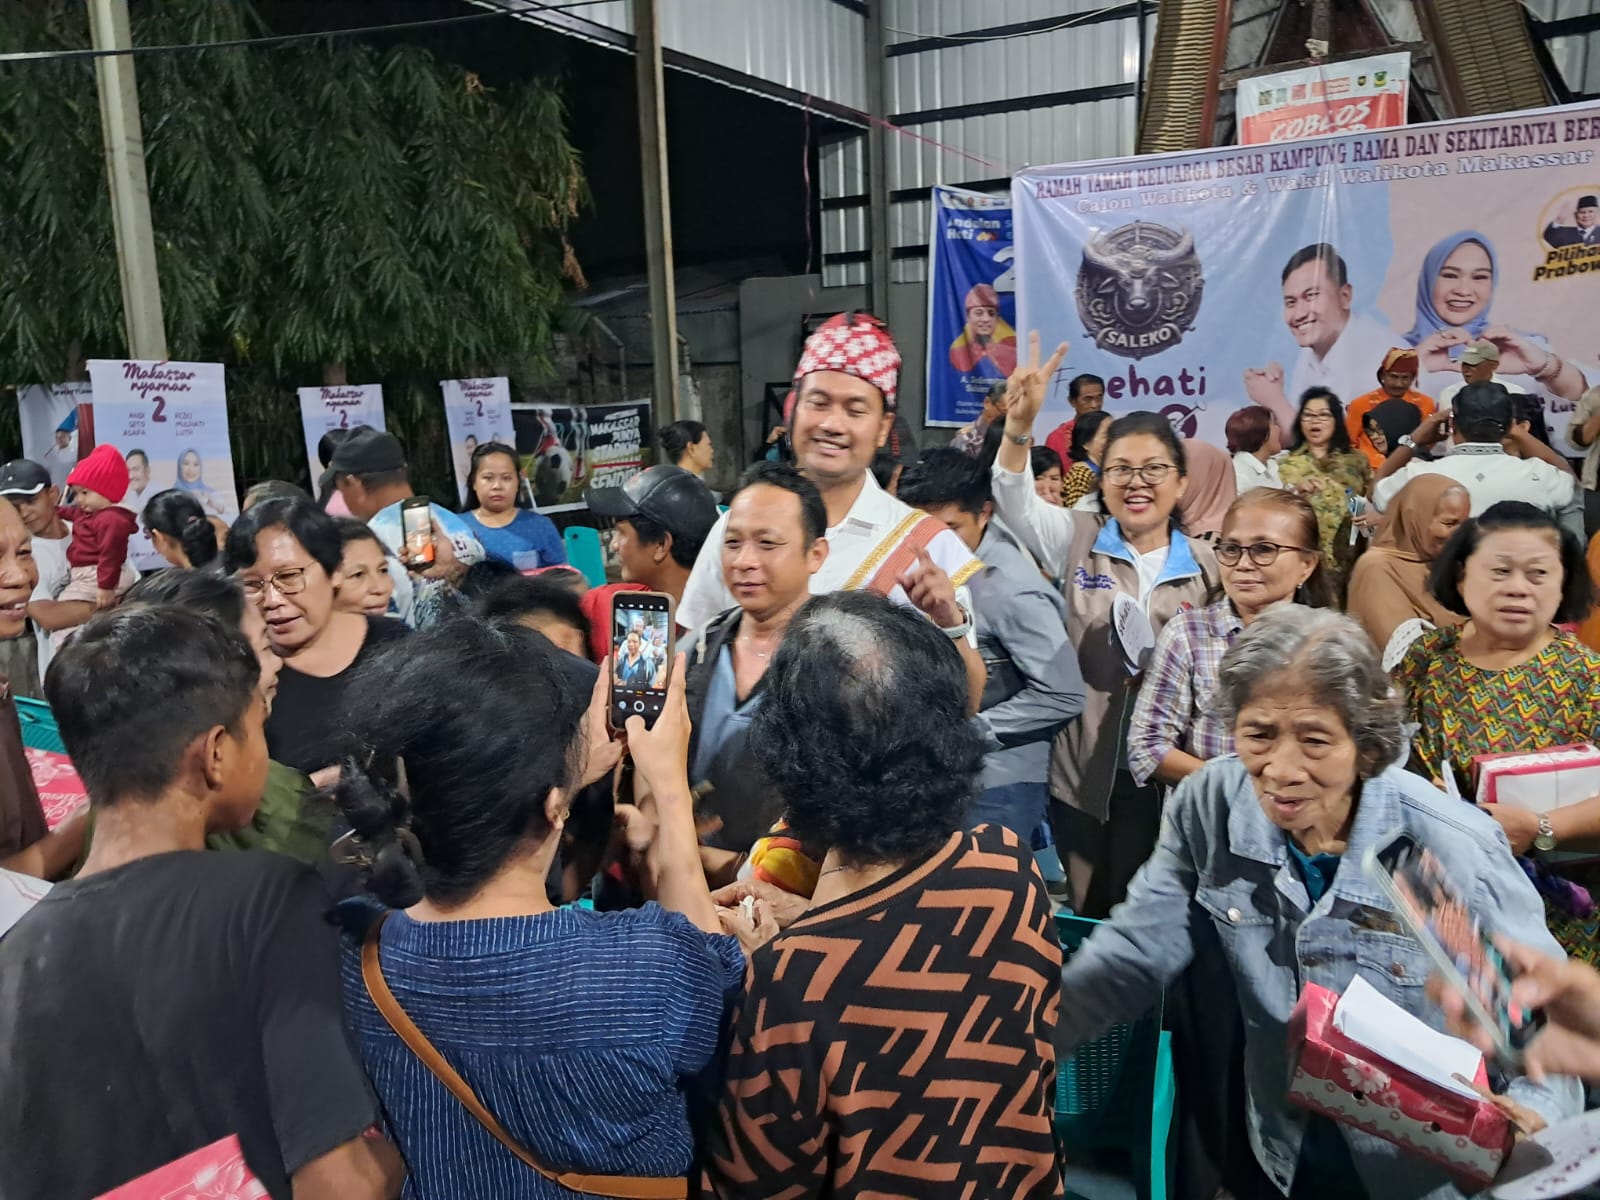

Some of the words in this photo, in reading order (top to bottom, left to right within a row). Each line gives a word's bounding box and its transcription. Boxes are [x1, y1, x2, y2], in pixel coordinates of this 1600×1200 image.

[1036, 177, 1082, 200] RAMAH
[1087, 170, 1132, 193] TAMAH
[1137, 161, 1211, 187] KELUARGA
[1217, 154, 1265, 178] BESAR
[1270, 142, 1347, 172] KAMPUNG
[1353, 138, 1399, 162] RAMA
[1405, 132, 1440, 157] DAN
[1446, 121, 1557, 153] SEKITARNYA
[1077, 197, 1133, 214] Calon
[1140, 186, 1233, 208] Walikota
[1241, 180, 1259, 197] &
[1267, 173, 1330, 192] Wakil
[1340, 161, 1449, 184] Walikota
[1456, 150, 1594, 174] Makassar
[1546, 245, 1600, 265] Piliha
[1105, 327, 1171, 348] SALEKO
[122, 362, 196, 381] Makassar
[1106, 363, 1207, 399] ehati
[130, 382, 191, 399] nyaman
[151, 395, 168, 422] 2
[1551, 400, 1576, 413] Lut
[340, 409, 349, 428] 2
